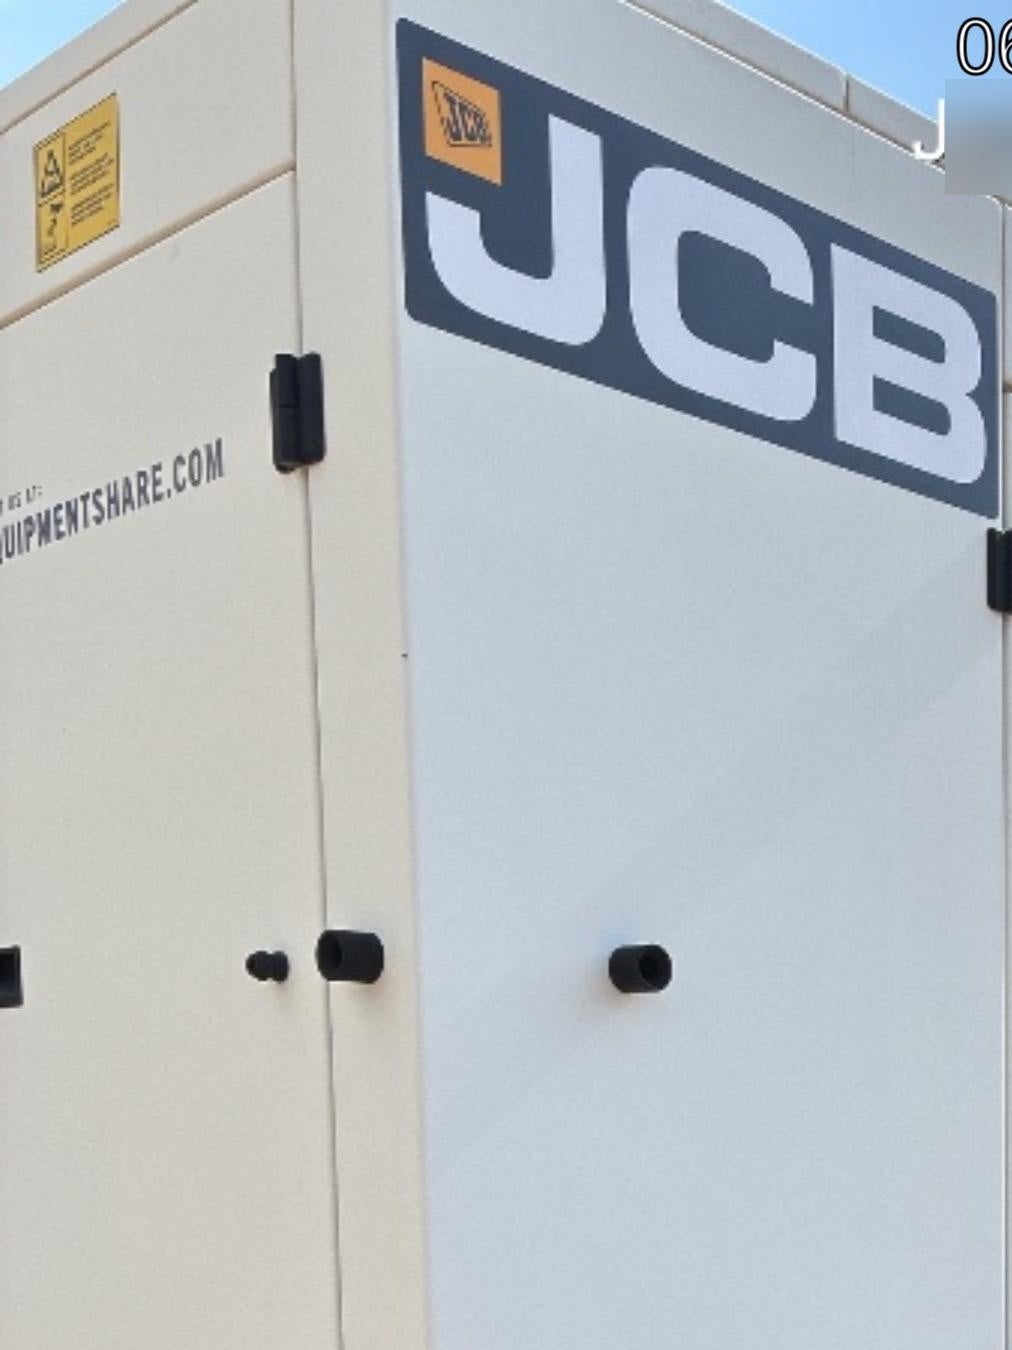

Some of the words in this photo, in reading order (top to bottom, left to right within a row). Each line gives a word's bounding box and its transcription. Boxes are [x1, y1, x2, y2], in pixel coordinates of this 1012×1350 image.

[442, 91, 489, 142] JCB
[425, 113, 988, 485] JCB
[0, 437, 224, 565] UIPMENTSHARE.COM
